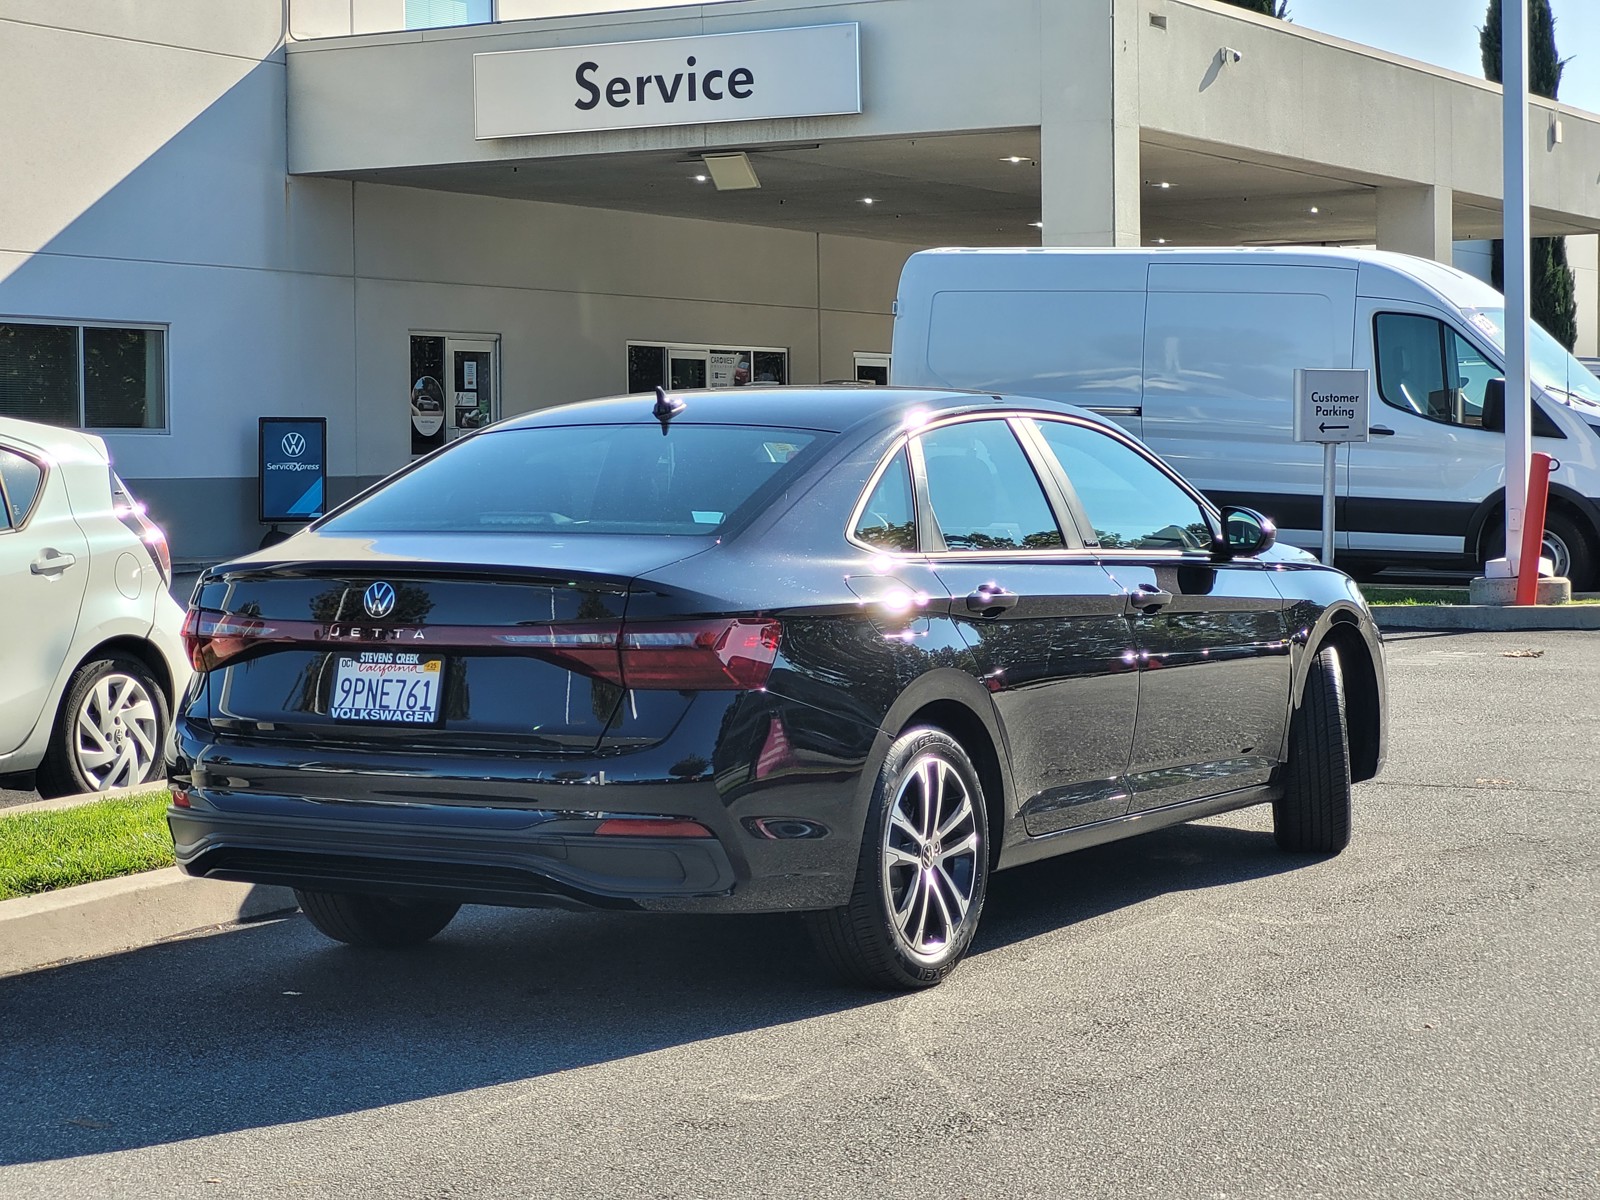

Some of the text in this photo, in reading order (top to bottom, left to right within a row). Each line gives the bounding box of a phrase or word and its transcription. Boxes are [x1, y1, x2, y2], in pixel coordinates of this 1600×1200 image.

[574, 55, 755, 111] Service
[1311, 391, 1360, 403] Customer
[1315, 405, 1355, 419] Parking
[266, 462, 320, 471] ServiceXpress
[331, 626, 425, 639] JETTA
[360, 652, 420, 664] STEVENS CREEK
[358, 663, 423, 678] California
[338, 677, 431, 711] 9PNE761
[331, 707, 435, 723] VOLKSWAGEN
